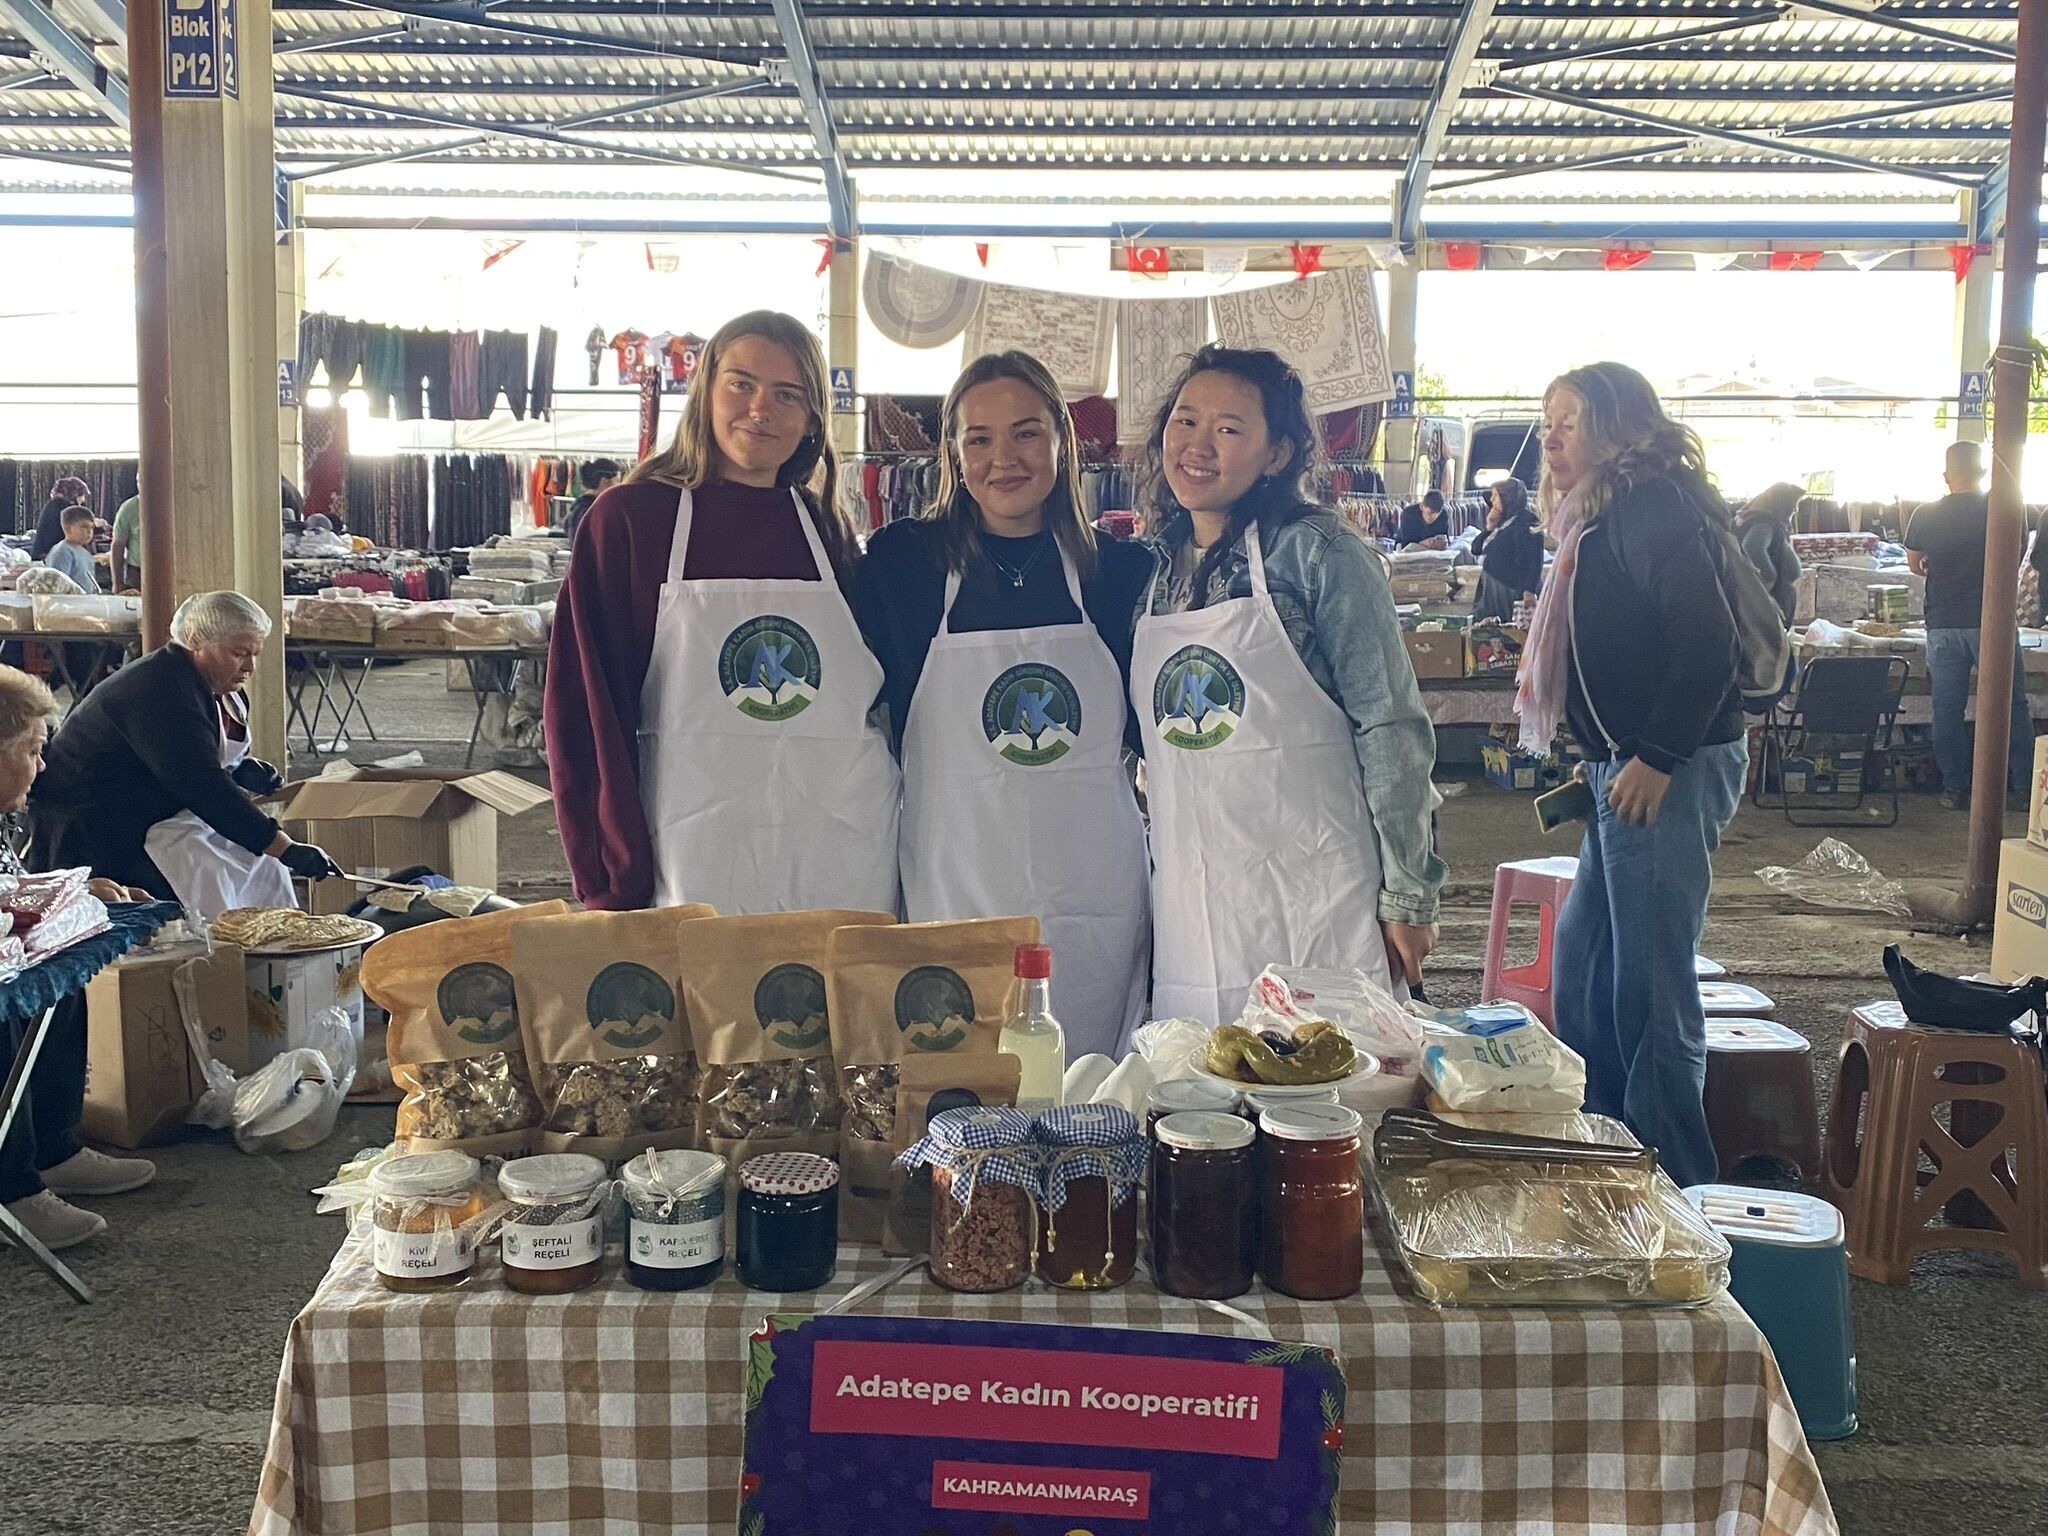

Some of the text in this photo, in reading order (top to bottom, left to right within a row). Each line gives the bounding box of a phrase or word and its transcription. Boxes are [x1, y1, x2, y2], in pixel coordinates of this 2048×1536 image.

[171, 15, 210, 37] Blok
[171, 52, 212, 86] P12
[624, 345, 637, 365] 9
[683, 350, 696, 371] 9
[279, 362, 290, 379] A
[834, 370, 849, 386] A
[1395, 374, 1409, 390] A
[1966, 375, 1981, 391] A
[280, 389, 293, 400] 13
[1490, 659, 1520, 669] SEBASTI
[2012, 892, 2043, 918] sarten
[532, 1234, 572, 1248] ŞEFTALİ
[409, 1246, 429, 1256] KİVİ
[534, 1247, 570, 1260] REÇELİ
[667, 1246, 702, 1259] REÇELİ
[402, 1257, 437, 1269] REÇELİ
[836, 1374, 1259, 1421] Adatepe Kadın Kooperatifi
[943, 1477, 1138, 1507] KAHRAMANMARAŞ
